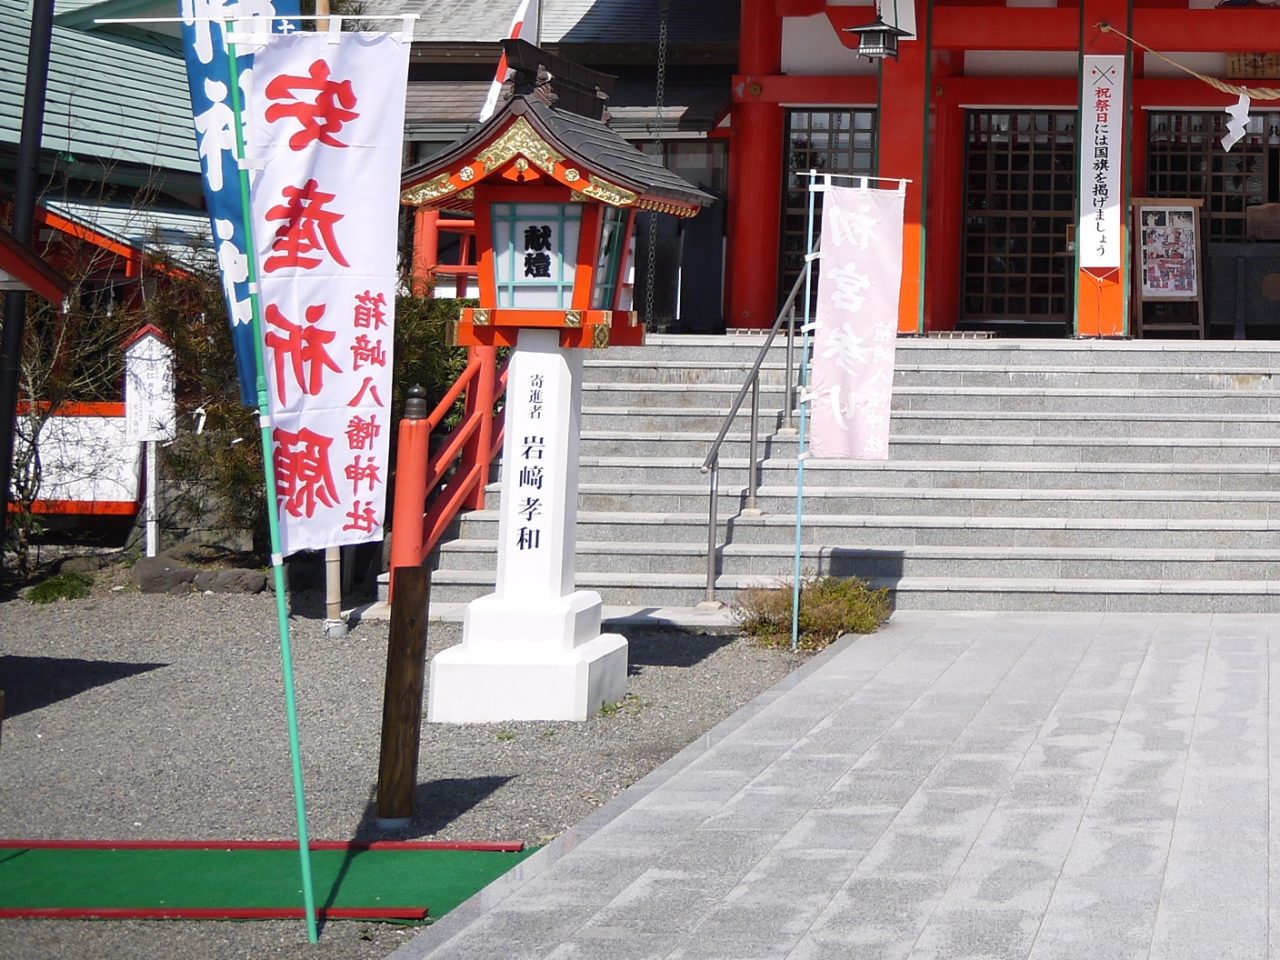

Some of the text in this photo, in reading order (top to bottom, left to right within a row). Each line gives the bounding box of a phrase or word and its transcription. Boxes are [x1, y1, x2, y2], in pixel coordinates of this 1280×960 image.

[1092, 87, 1111, 257] 祝祭日には国旗を掲げましょう
[528, 374, 545, 420] 寄進者
